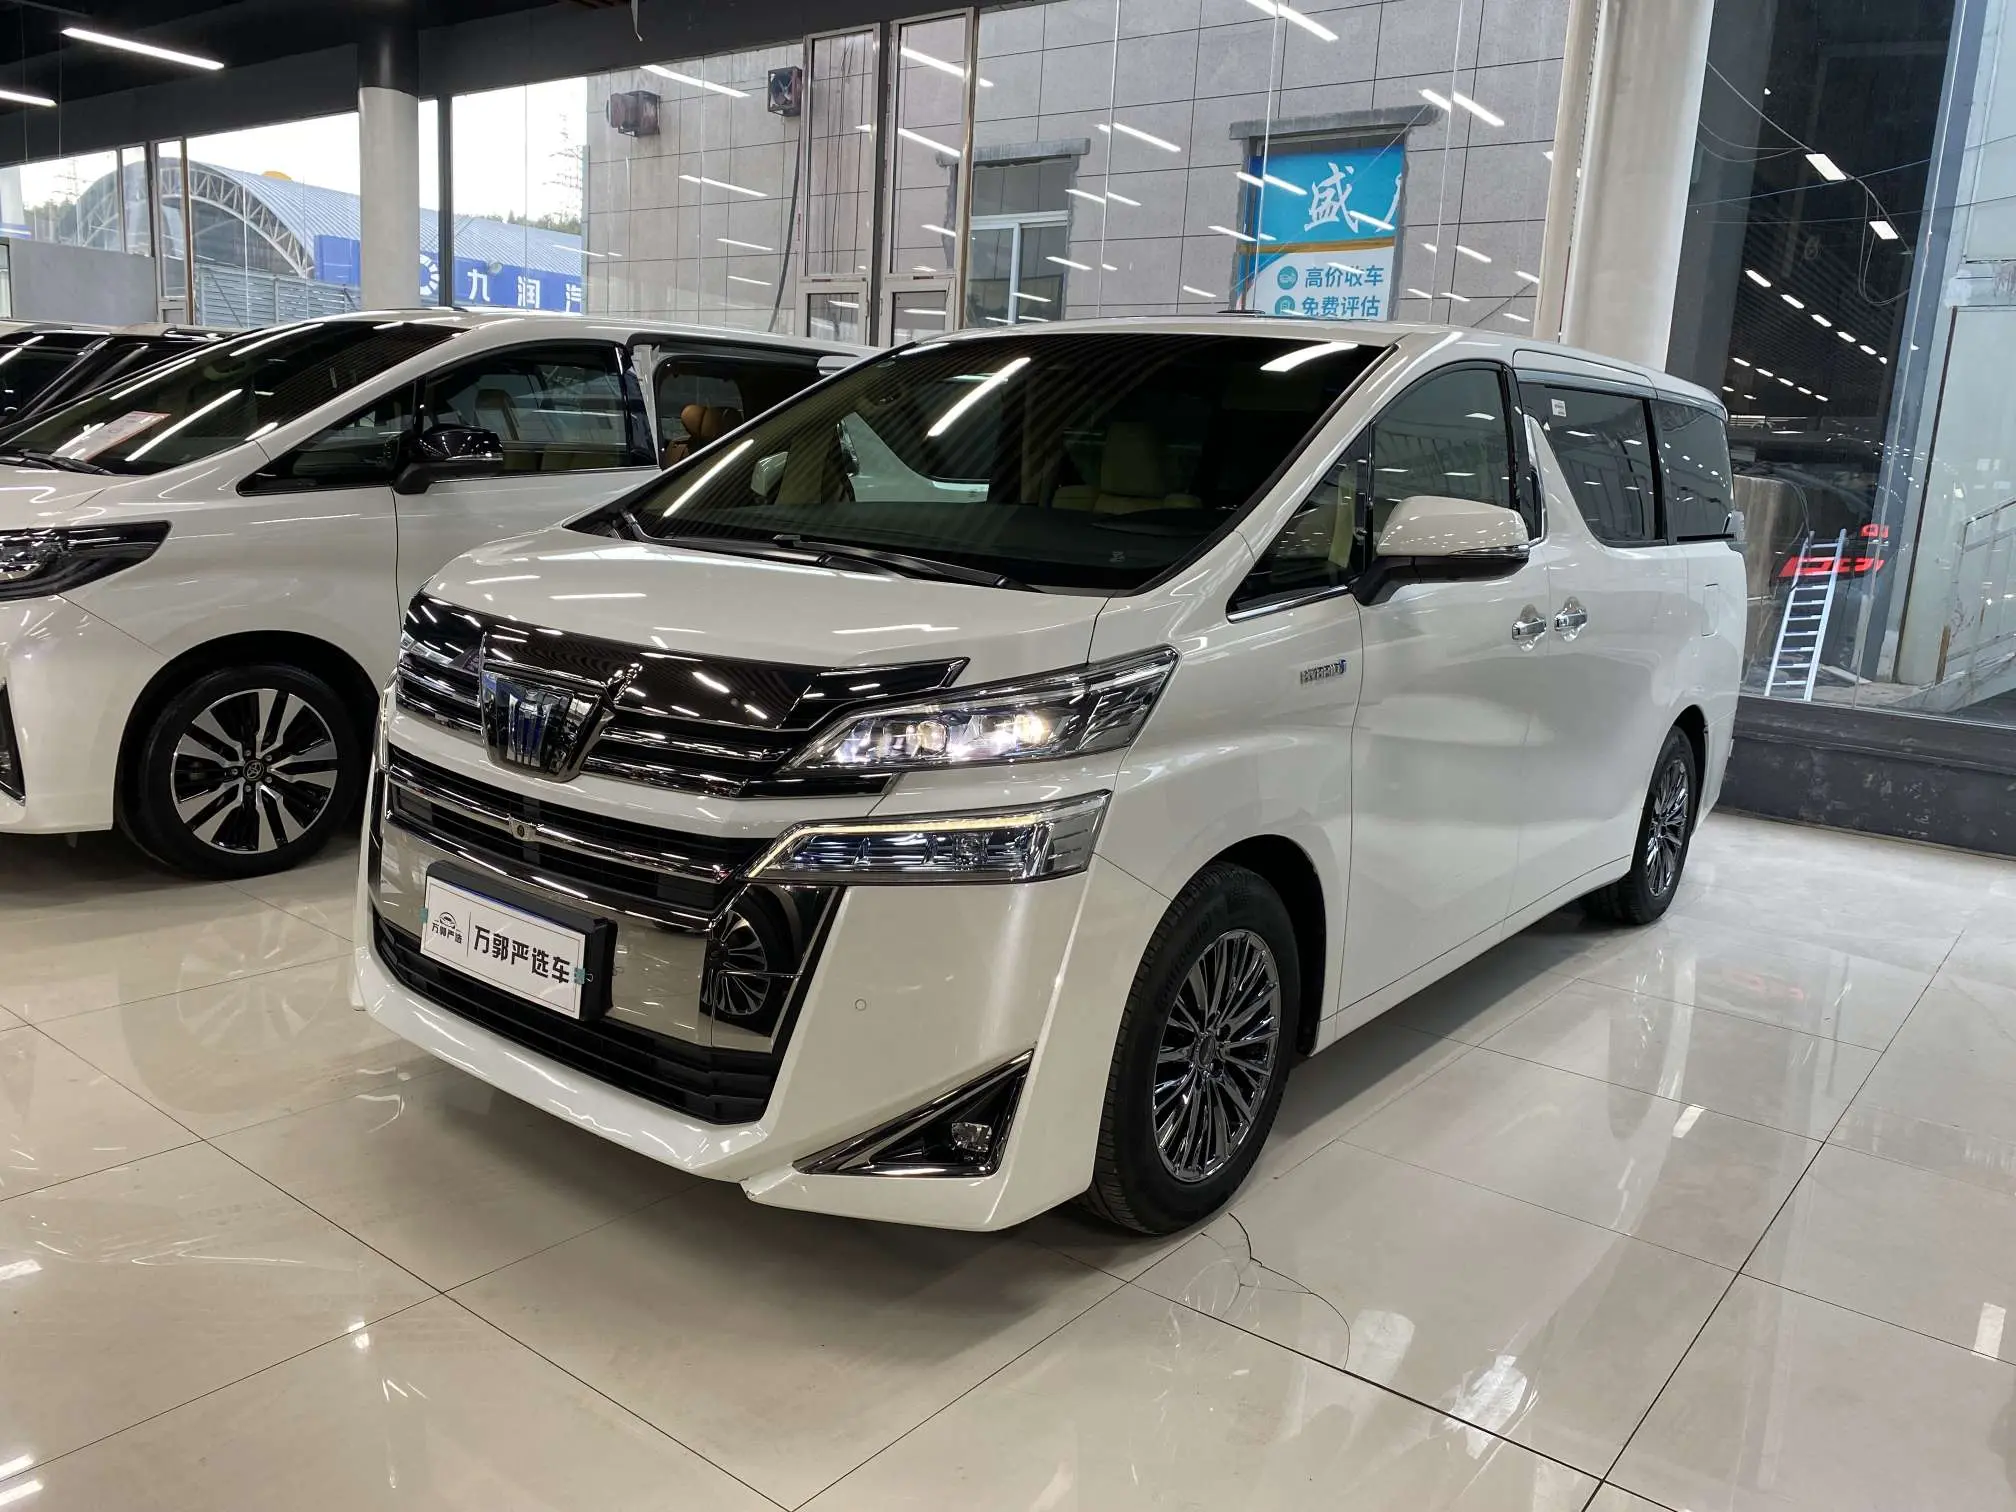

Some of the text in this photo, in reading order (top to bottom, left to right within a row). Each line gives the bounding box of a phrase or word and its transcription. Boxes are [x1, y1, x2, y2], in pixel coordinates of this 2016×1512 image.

[1304, 162, 1401, 233] 盛
[1305, 265, 1384, 288] 高价收车
[1302, 296, 1380, 318] 免费评估
[474, 925, 570, 984] 万郭严选车
